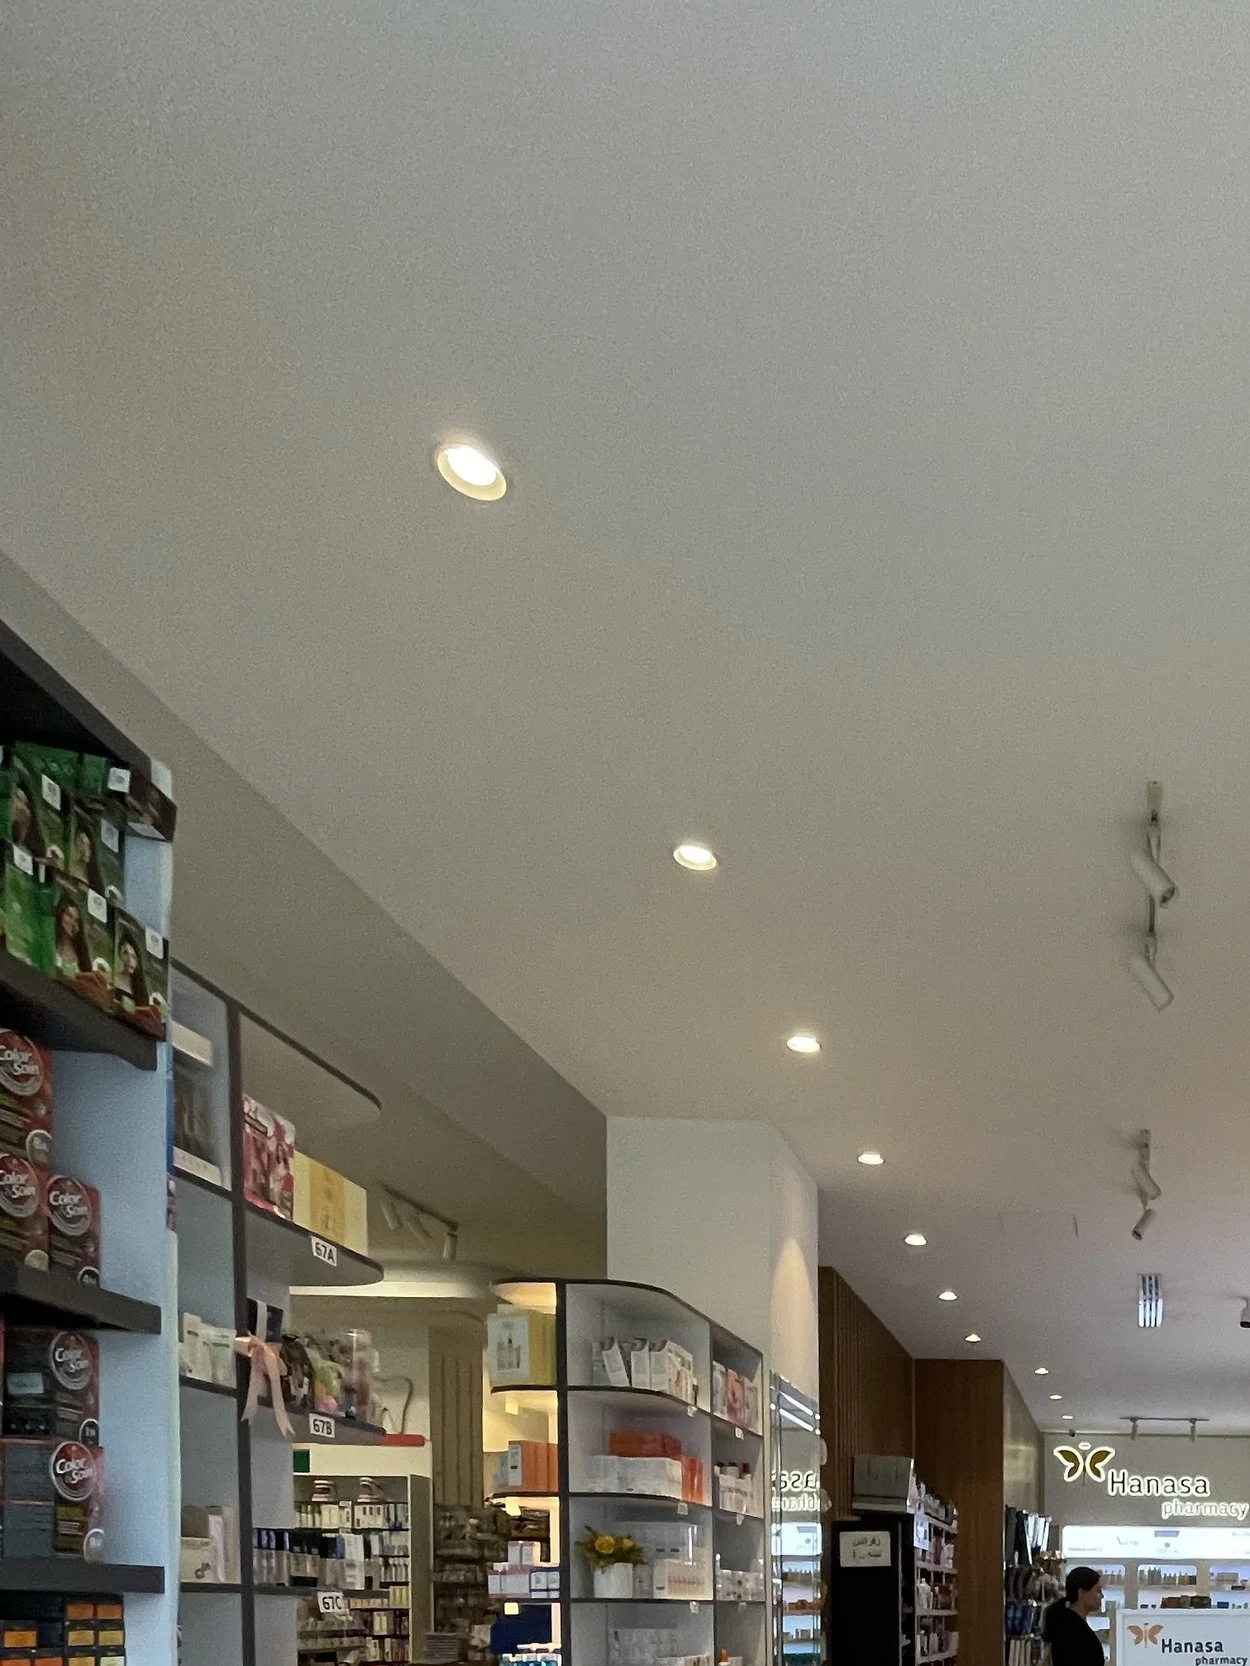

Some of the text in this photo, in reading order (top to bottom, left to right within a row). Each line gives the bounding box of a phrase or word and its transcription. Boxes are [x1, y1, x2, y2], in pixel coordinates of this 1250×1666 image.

[315, 1241, 336, 1264] 67A
[313, 1418, 333, 1436] 67B
[1107, 1469, 1210, 1497] Hanasa
[1160, 1498, 1250, 1520] pharmacy
[322, 1595, 342, 1611] 67C
[1161, 1638, 1223, 1653] Hanasa
